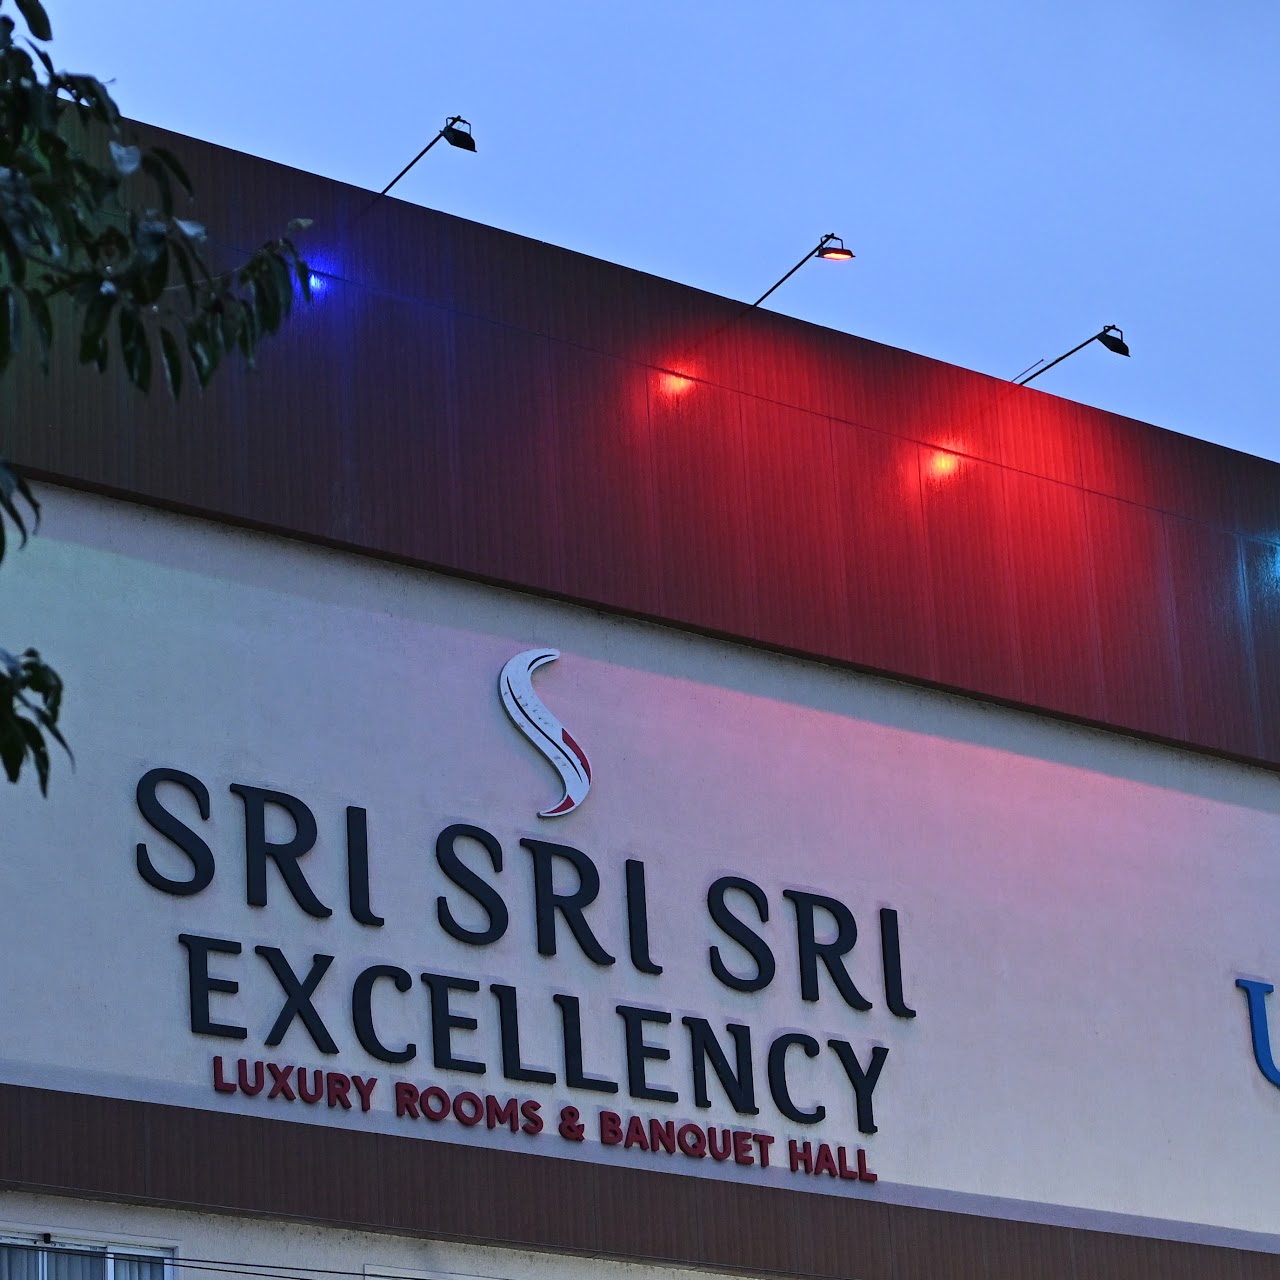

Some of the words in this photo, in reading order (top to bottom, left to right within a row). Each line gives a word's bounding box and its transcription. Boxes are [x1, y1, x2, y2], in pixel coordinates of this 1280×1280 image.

[135, 767, 385, 927] SRI
[434, 823, 663, 975] SRI
[707, 876, 917, 1018] SRI
[178, 933, 889, 1135] EXCELLENCY
[212, 1055, 377, 1113] LUXURY
[395, 1082, 544, 1136] ROOMS
[559, 1106, 584, 1142] &
[600, 1110, 775, 1168] BANQUET
[789, 1139, 878, 1182] HALL
